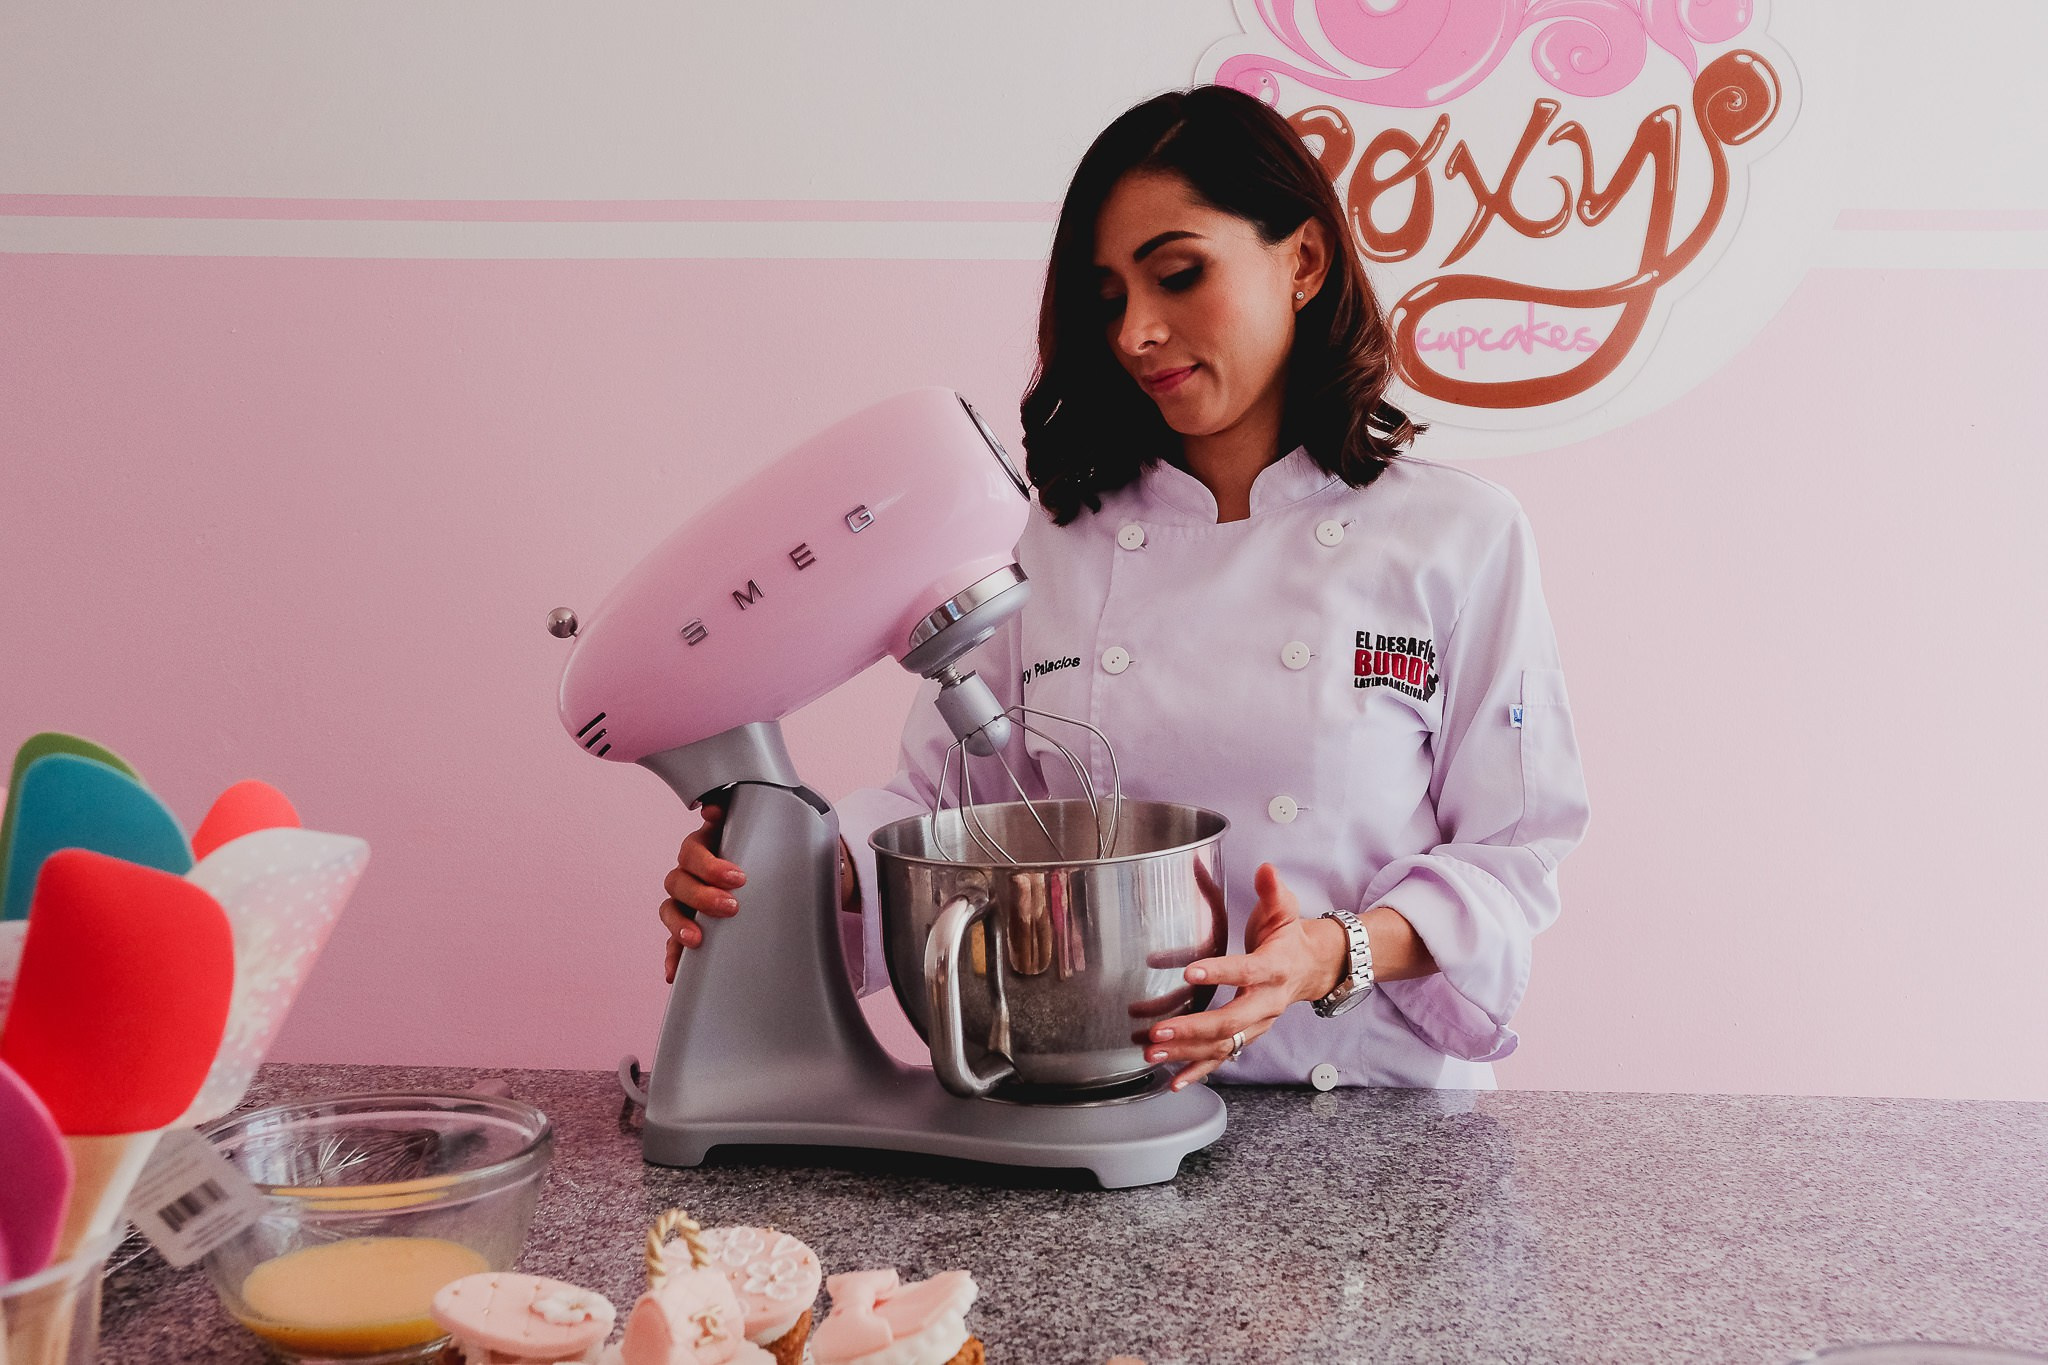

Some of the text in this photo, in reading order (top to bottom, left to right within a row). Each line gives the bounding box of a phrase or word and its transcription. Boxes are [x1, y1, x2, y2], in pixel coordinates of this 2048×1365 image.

[1416, 301, 1600, 370] cupcakes
[680, 504, 875, 647] SMEG
[1355, 631, 1373, 650] EL
